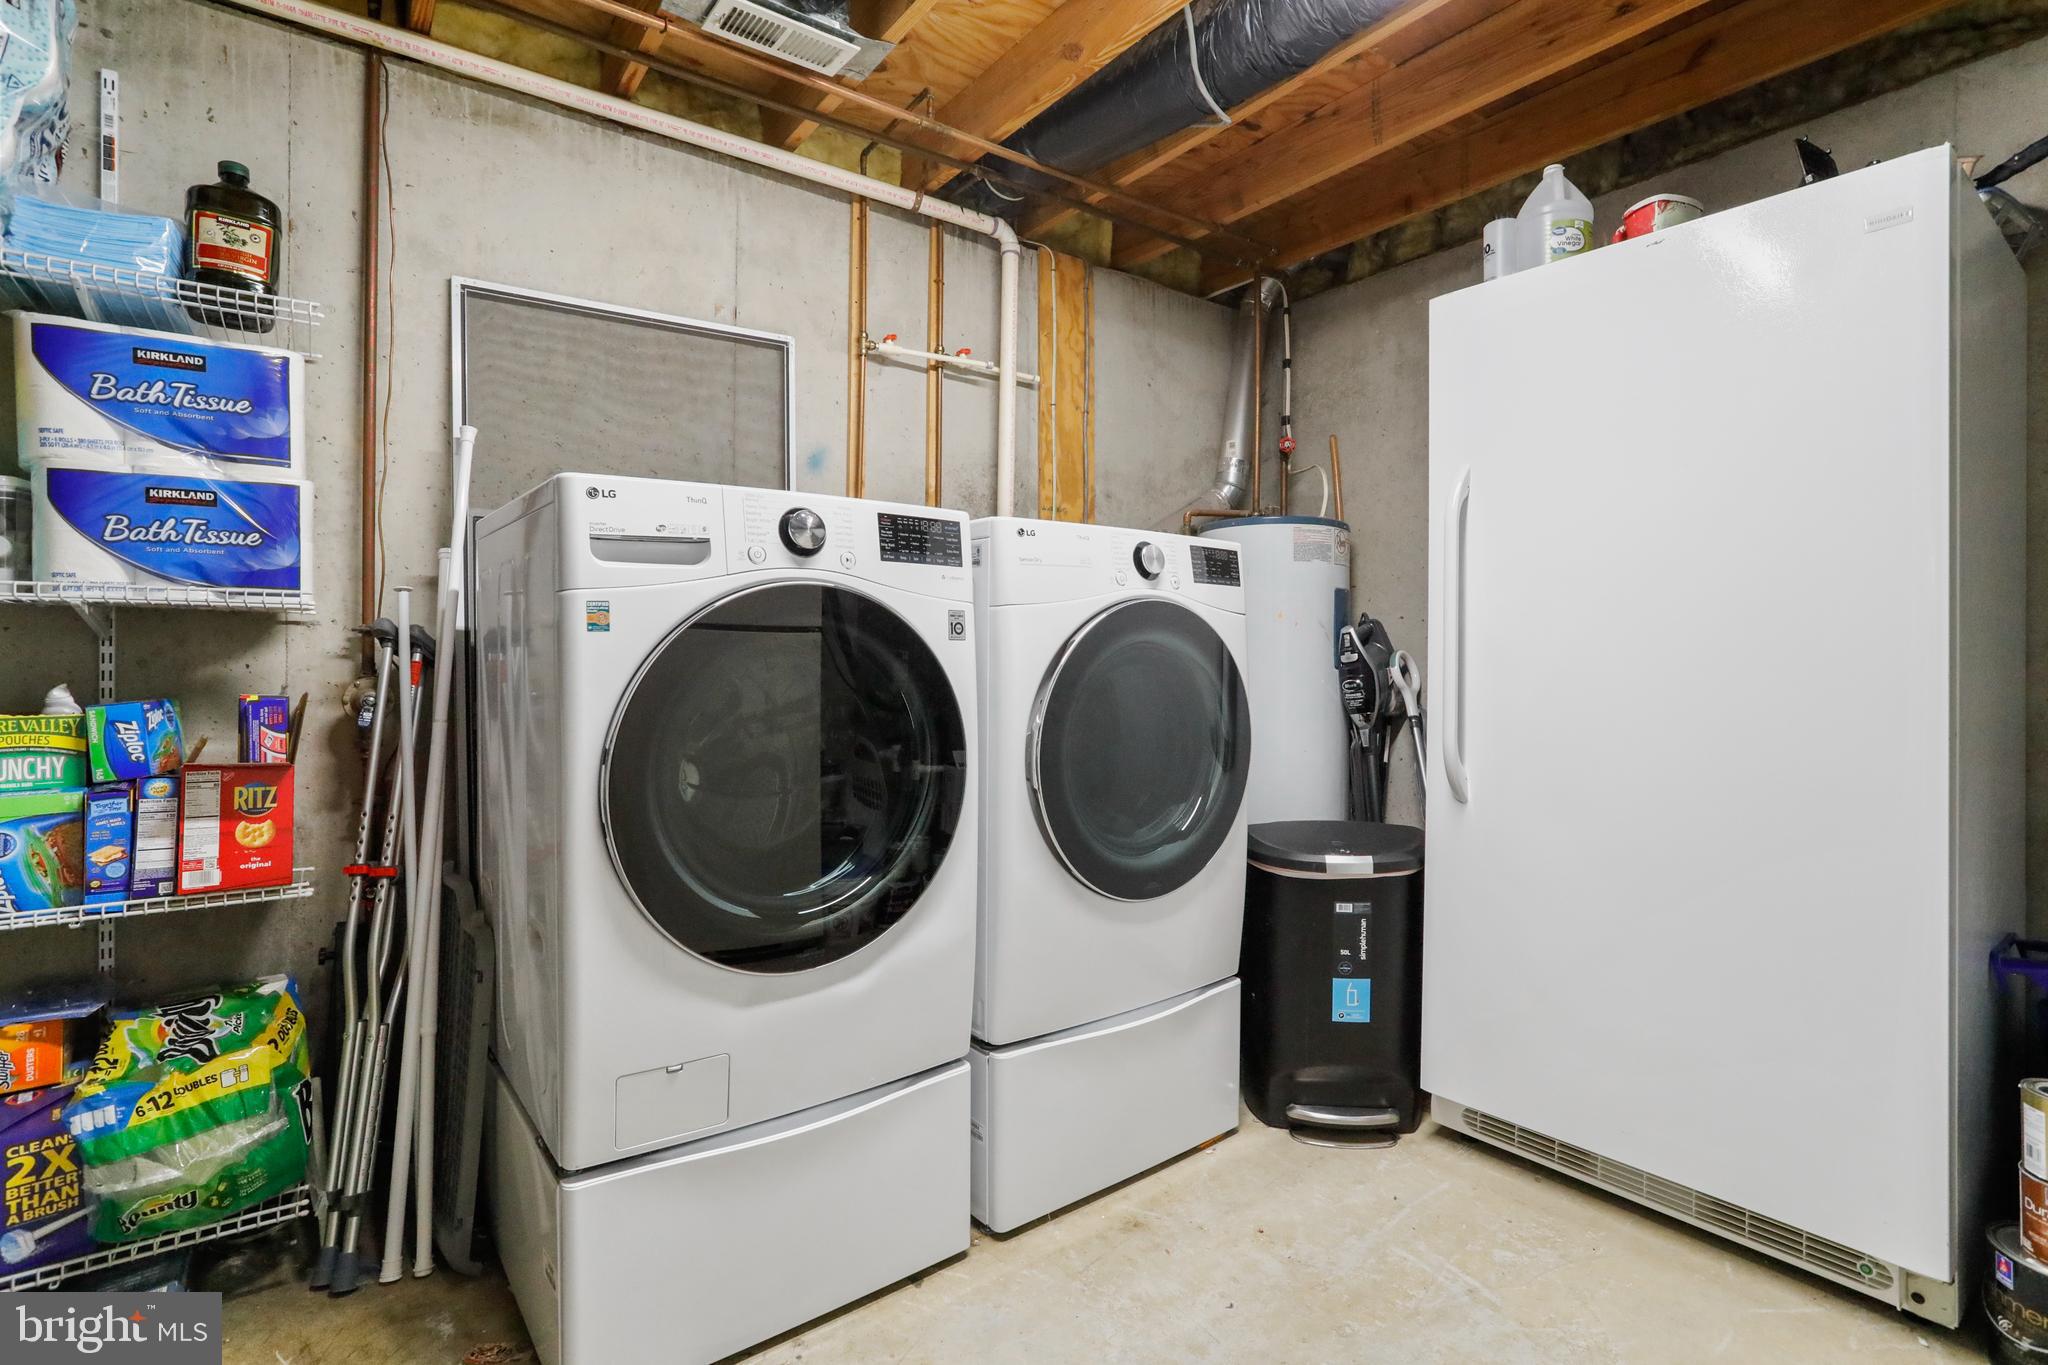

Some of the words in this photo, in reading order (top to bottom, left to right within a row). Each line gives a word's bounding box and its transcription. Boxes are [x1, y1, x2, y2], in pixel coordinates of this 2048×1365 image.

[218, 216, 250, 227] KIRKLAND
[136, 349, 204, 366] KIRKLAND
[90, 373, 172, 405] Bath
[170, 381, 252, 414] Tissue
[172, 411, 215, 421] Absorbent
[149, 488, 215, 501] KIRKLAND
[602, 489, 617, 499] LG
[103, 514, 183, 542] Bath
[182, 519, 262, 546] Tissue
[183, 547, 225, 555] Absorbent
[19, 718, 80, 737] VALLEY
[88, 710, 98, 744] SANDWICH
[115, 720, 146, 762] Ziploc
[234, 785, 278, 811] RITZ
[239, 861, 272, 870] original
[1359, 918, 1368, 960] simplehuman
[25, 1047, 35, 1081] DUSTERS
[135, 1105, 147, 1118] 6
[146, 1091, 176, 1113] 12
[5, 1183, 80, 1215] THAN
[6, 1170, 78, 1201] BETTER
[6, 1214, 20, 1227] A
[23, 1197, 80, 1222] BRUSH
